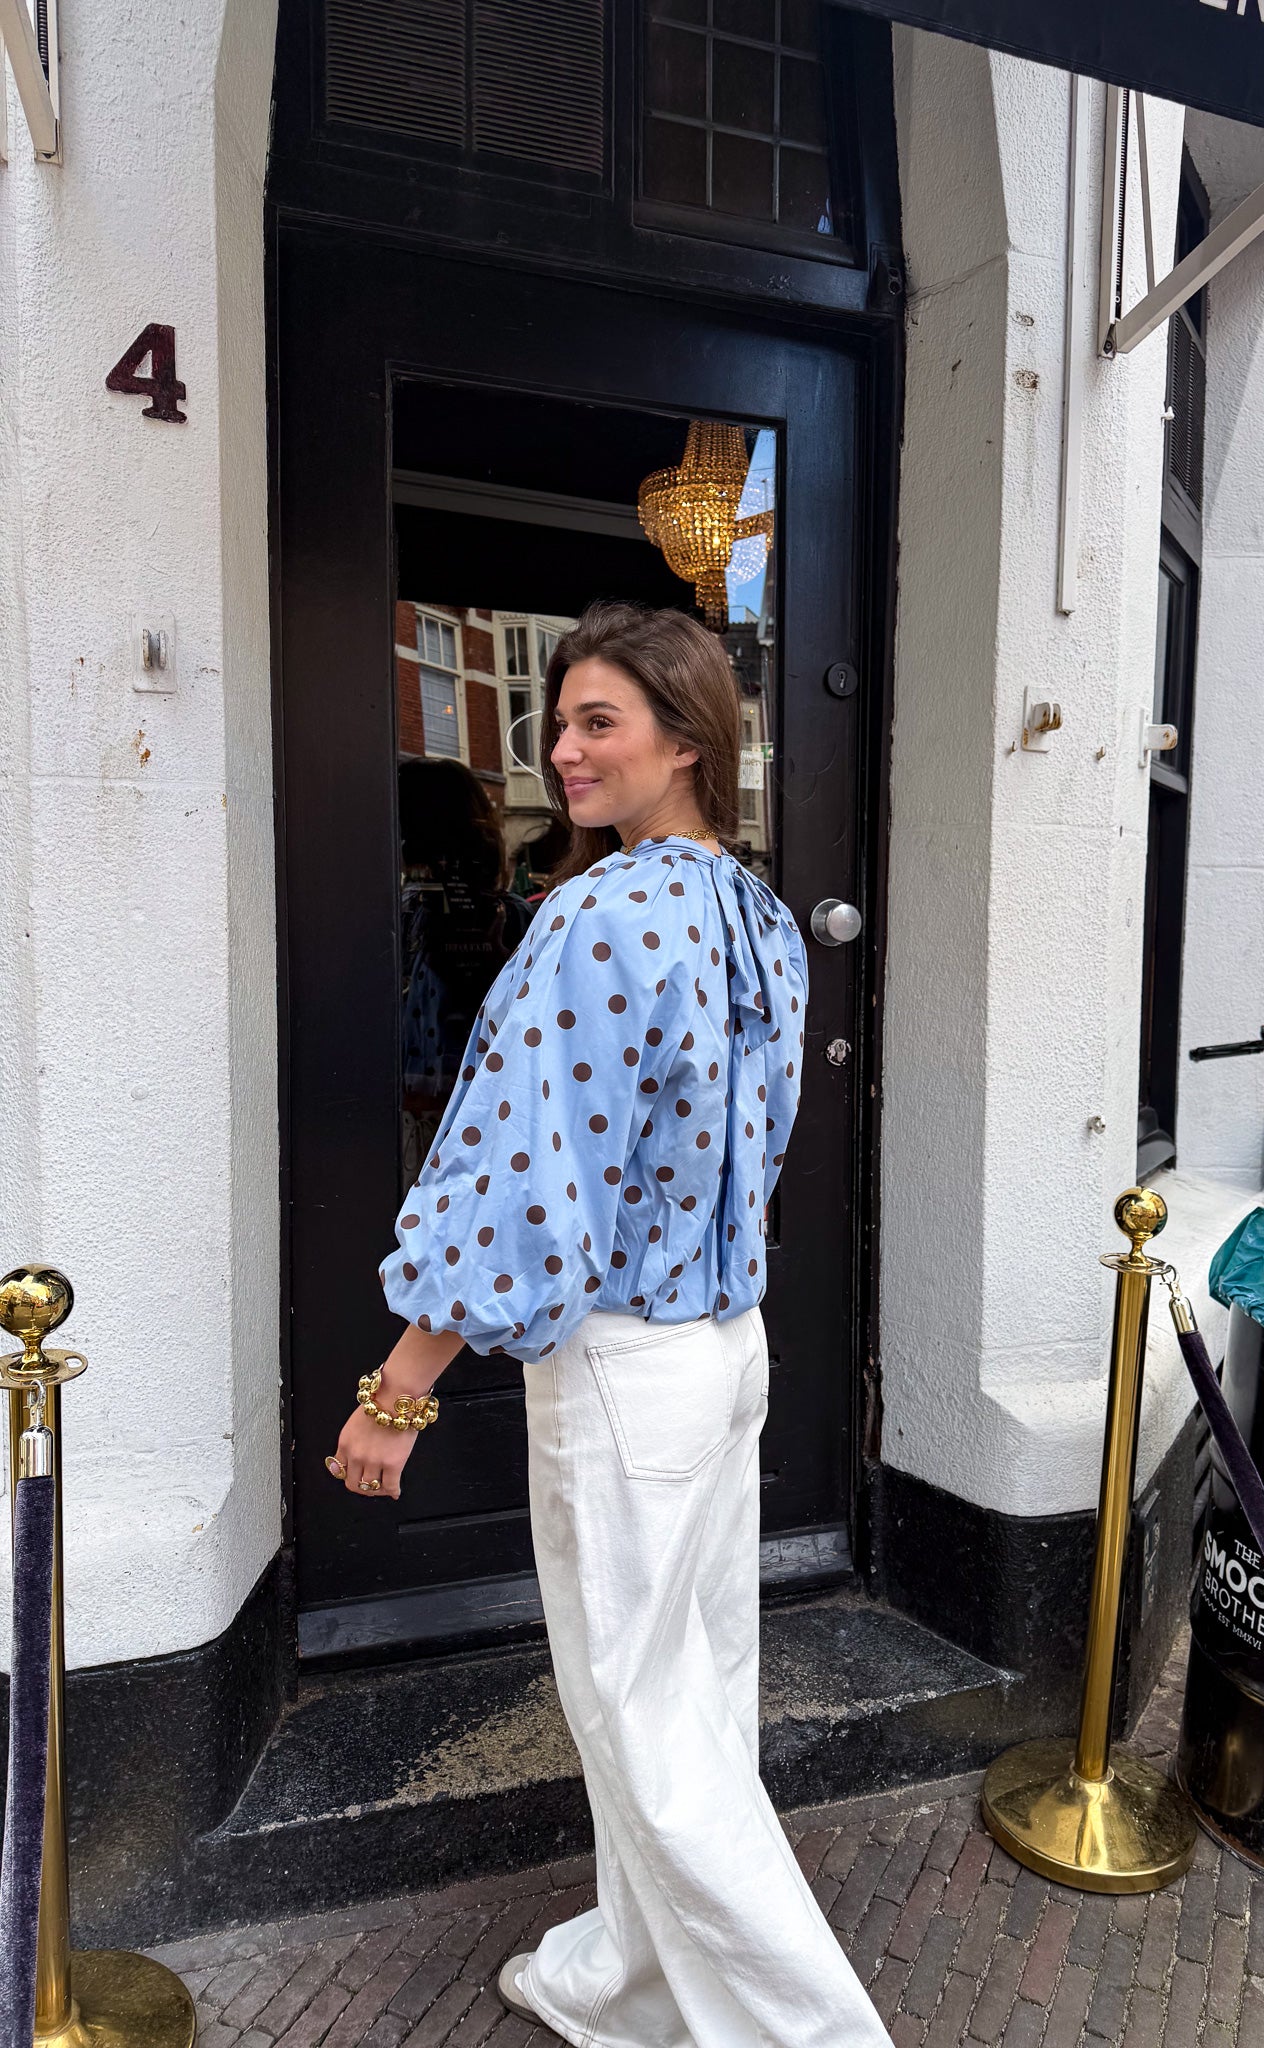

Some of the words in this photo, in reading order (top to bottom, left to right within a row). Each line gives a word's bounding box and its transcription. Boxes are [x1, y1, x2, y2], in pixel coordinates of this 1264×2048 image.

[105, 323, 187, 423] 4
[1234, 1539, 1262, 1570] THE
[1217, 1611, 1230, 1628] EST
[1232, 1623, 1262, 1651] MMXVI
